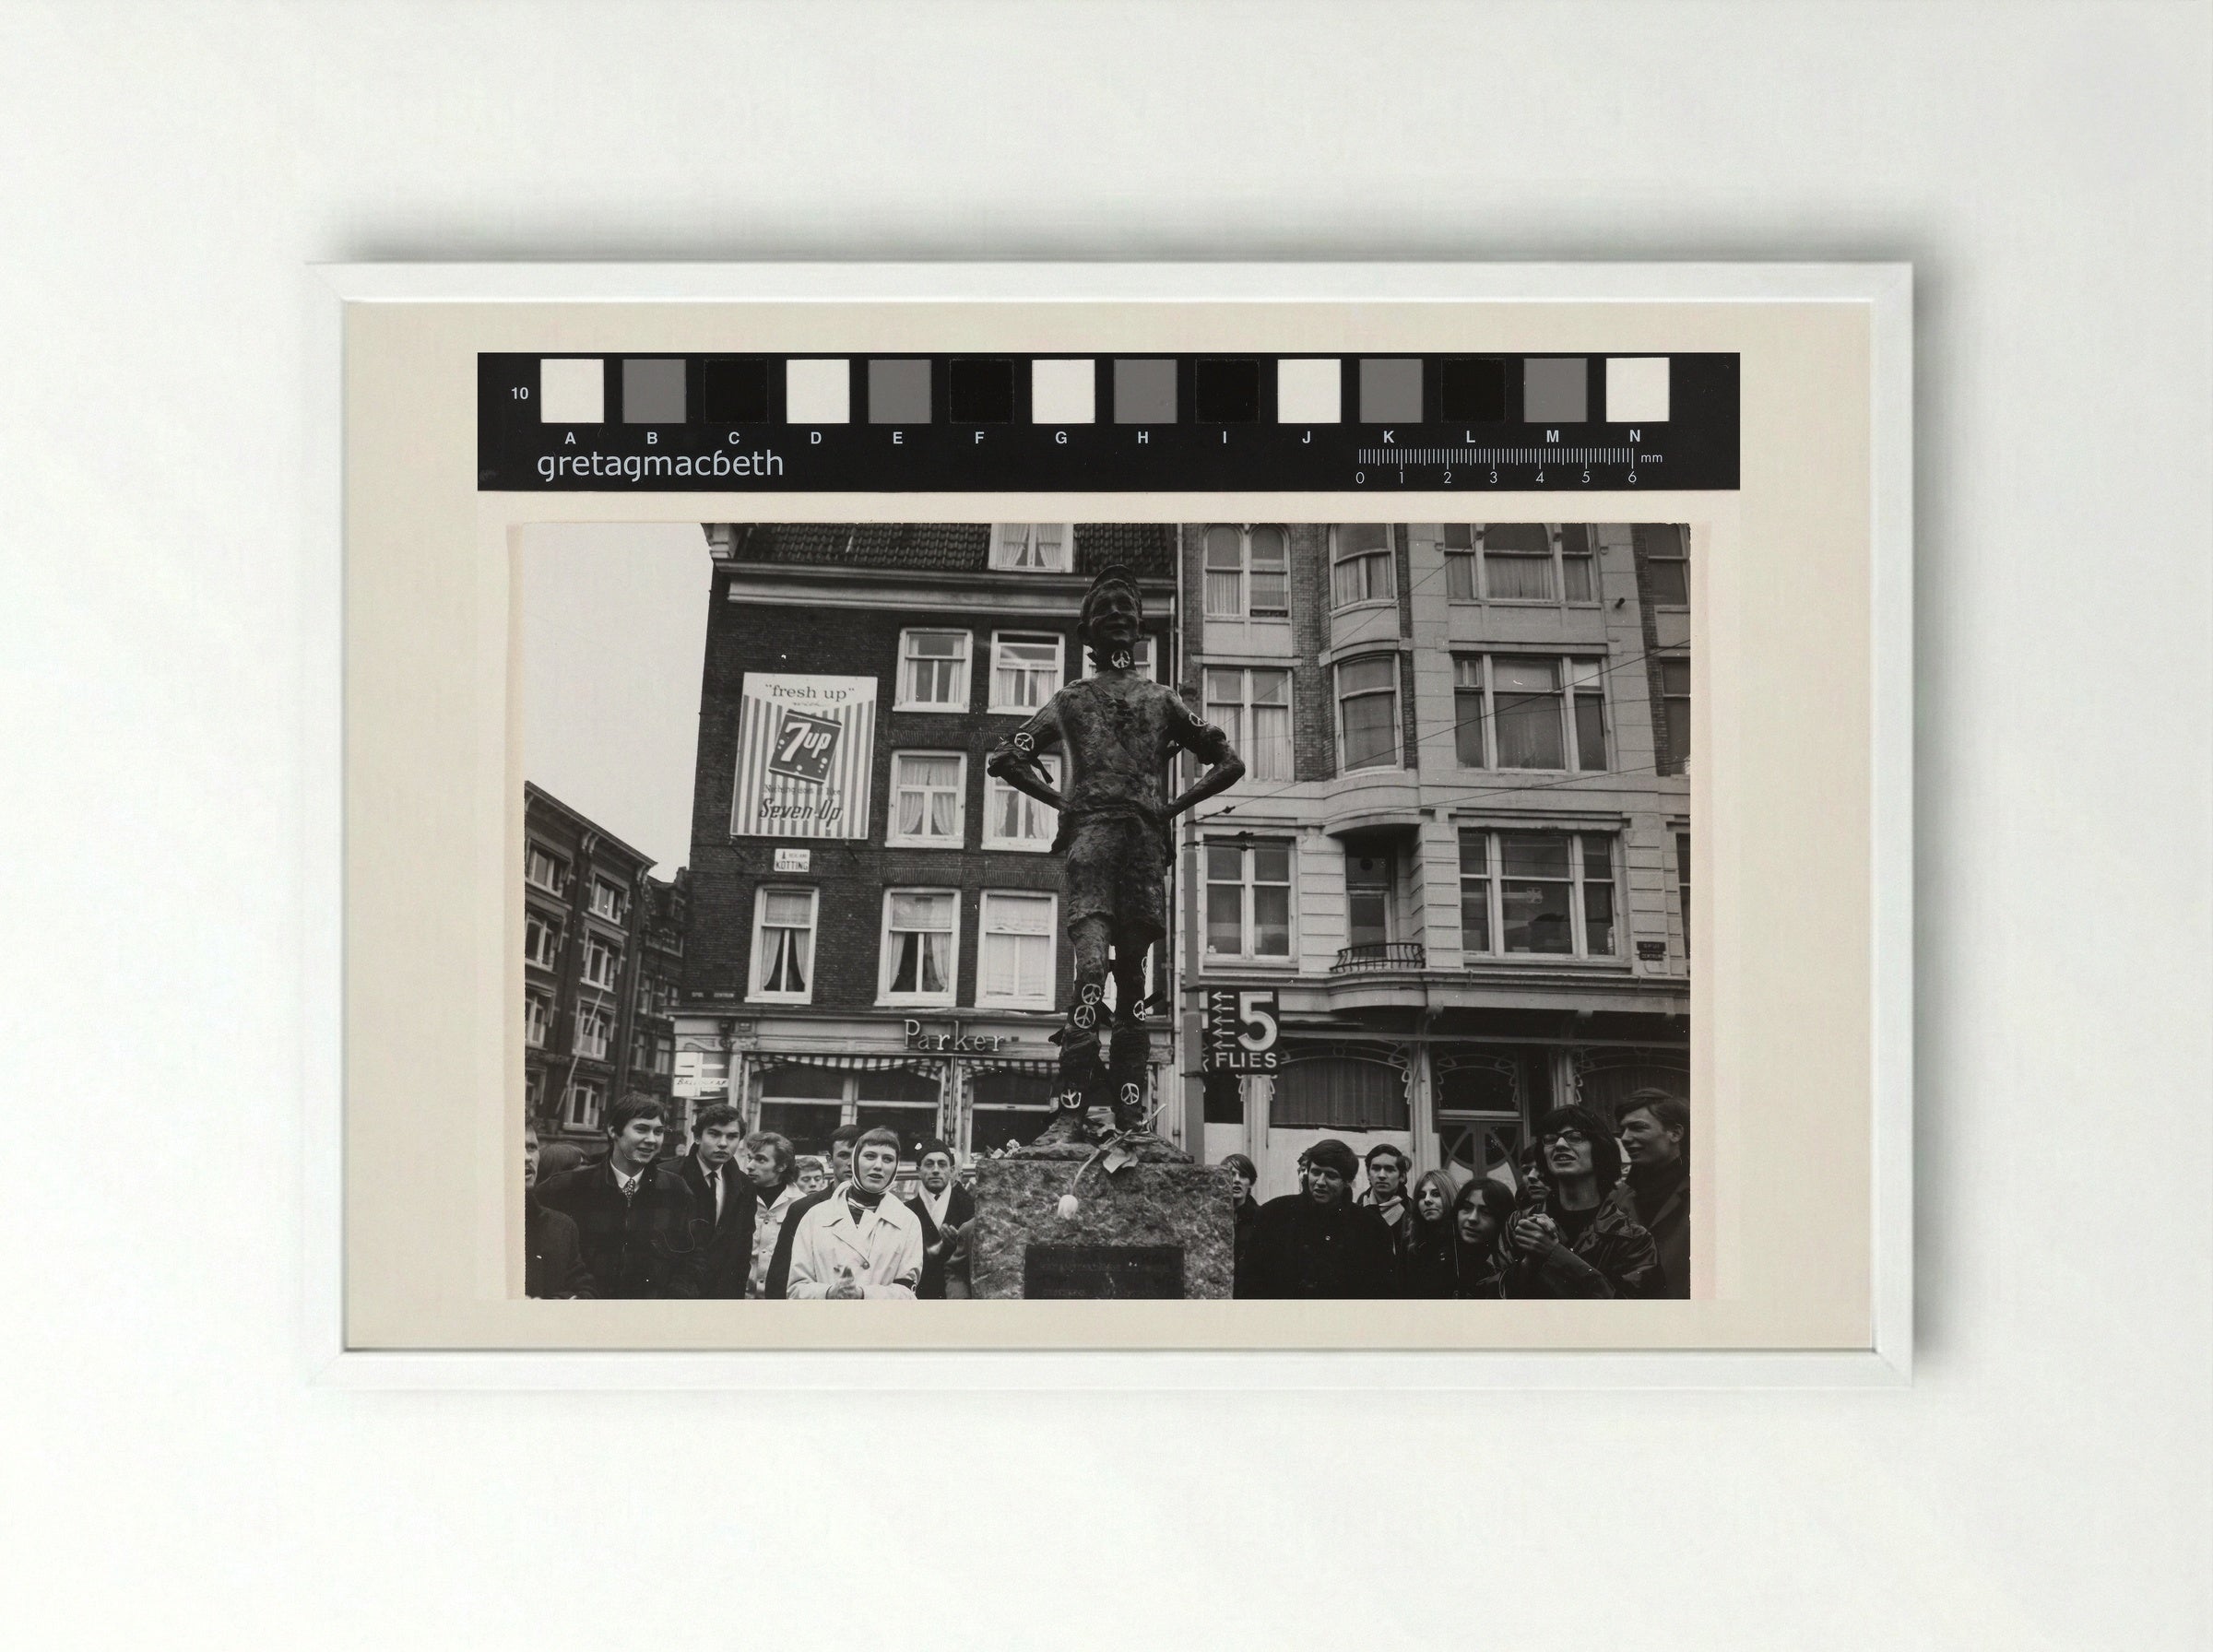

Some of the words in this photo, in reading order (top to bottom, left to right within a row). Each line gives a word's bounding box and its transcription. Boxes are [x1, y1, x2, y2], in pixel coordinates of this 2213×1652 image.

[511, 387, 529, 400] 10
[565, 432, 576, 444] A
[647, 432, 657, 444] B
[729, 431, 740, 444] C
[811, 432, 822, 444] D
[893, 432, 903, 444] E
[976, 431, 984, 443] F
[1056, 431, 1067, 444] G
[1138, 431, 1149, 443] H
[1303, 431, 1311, 443] J
[1384, 431, 1395, 442] K
[1466, 431, 1475, 442] L
[1547, 431, 1559, 442] M
[1630, 430, 1640, 442] N
[538, 449, 784, 482] gretagmacbeth
[1640, 454, 1663, 463] mm
[1355, 471, 1365, 484] 0
[1443, 471, 1452, 484] 2
[1489, 471, 1498, 484] 3
[1535, 471, 1544, 484] 4
[1581, 471, 1591, 484] 5
[1628, 471, 1637, 483] 6
[1237, 991, 1278, 1053] 5
[904, 1018, 1006, 1052] Parker
[1214, 1051, 1278, 1069] FLIES
